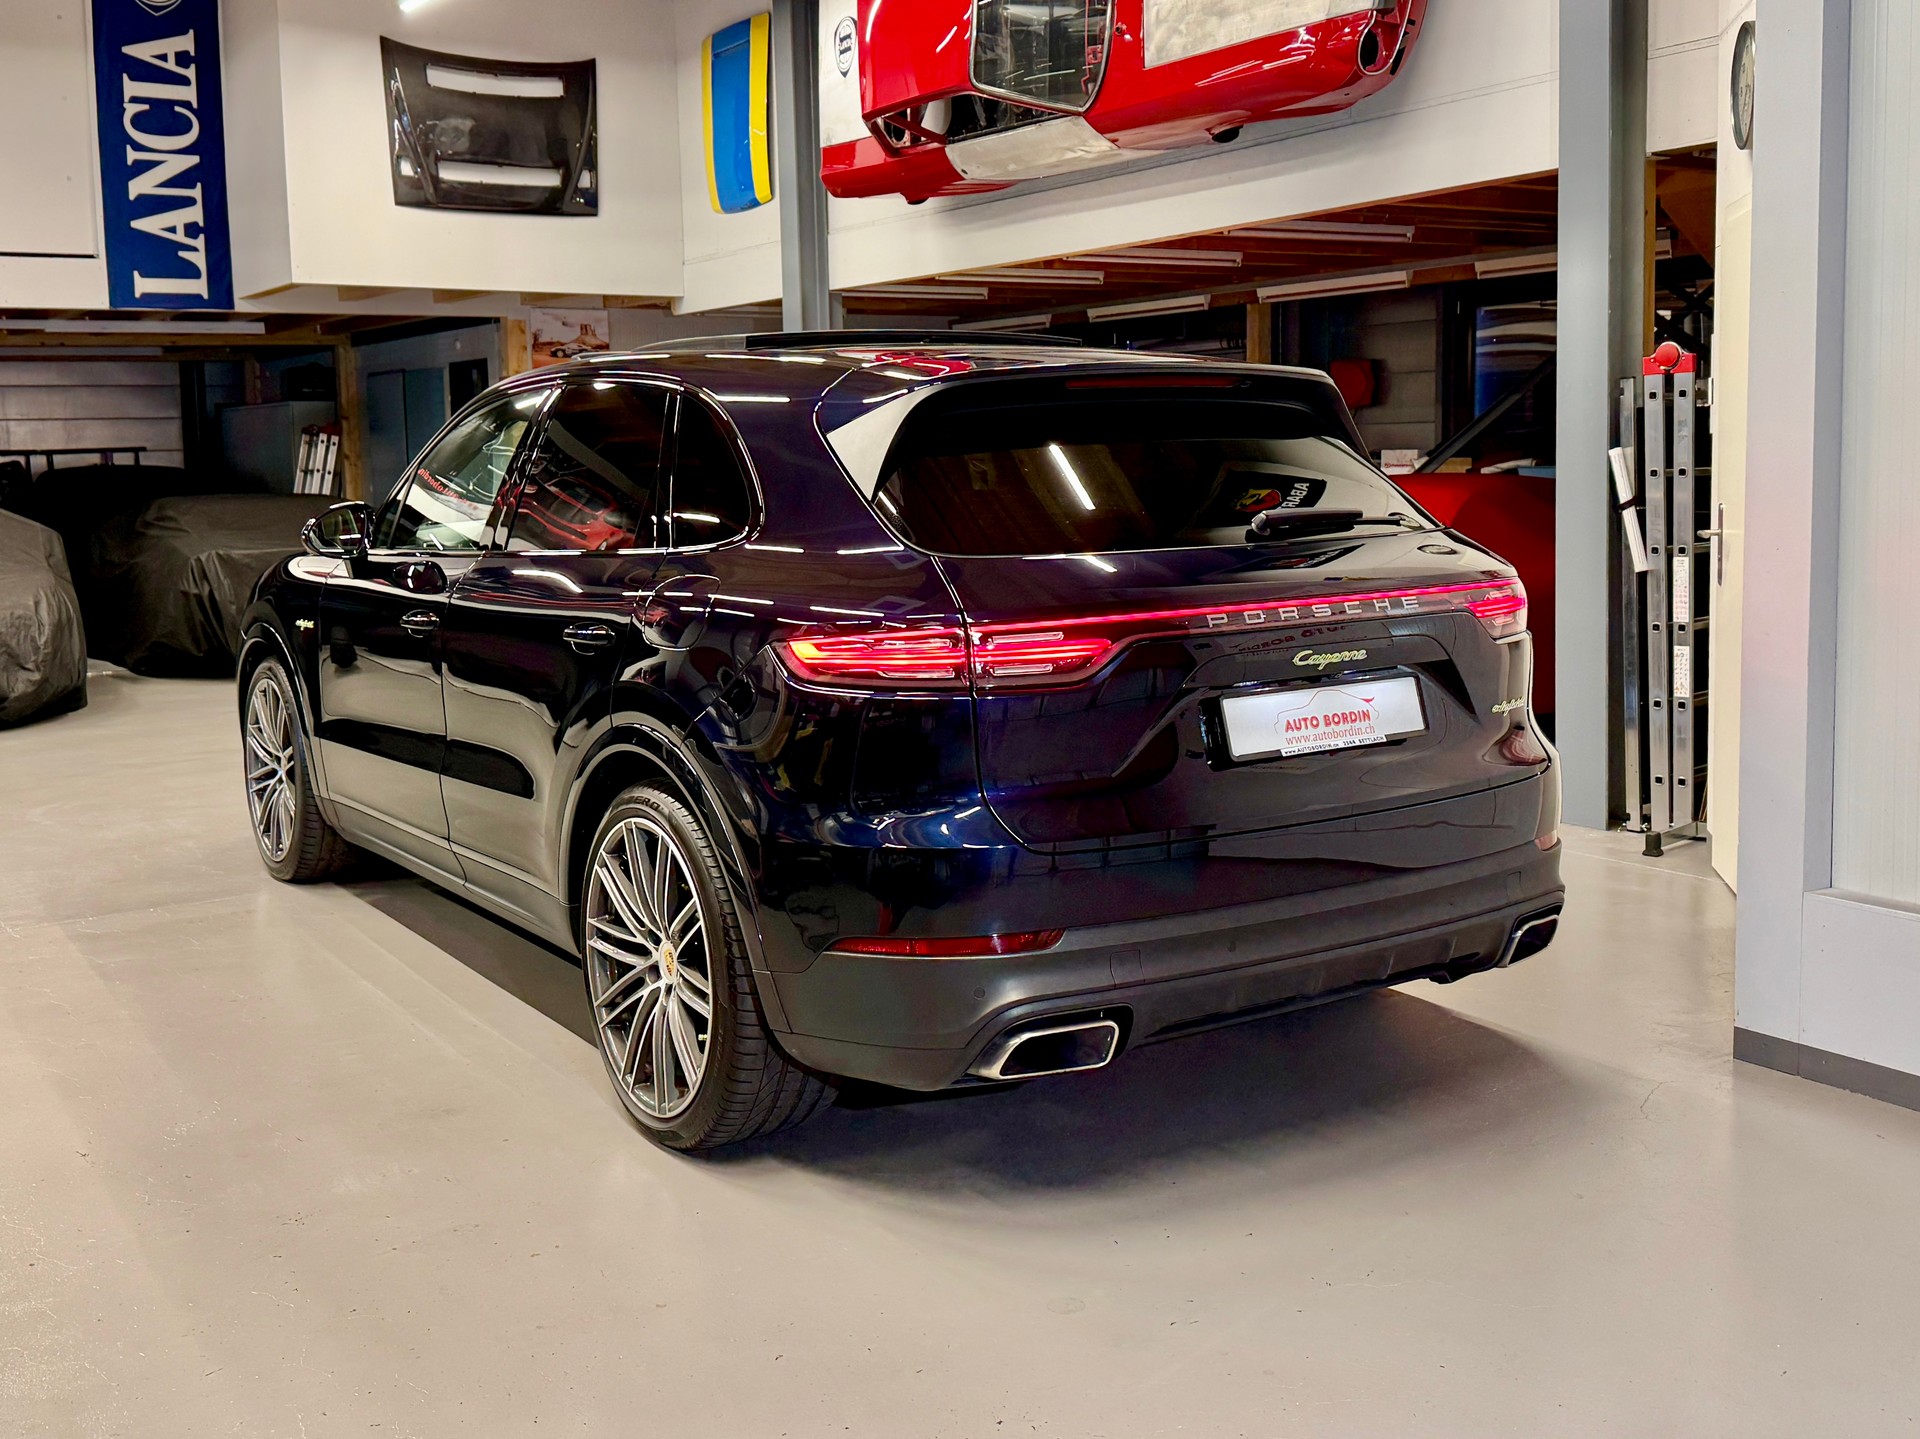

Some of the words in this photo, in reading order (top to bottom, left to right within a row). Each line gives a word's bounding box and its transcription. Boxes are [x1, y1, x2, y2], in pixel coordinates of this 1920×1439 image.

[121, 29, 209, 300] LANCIA
[1206, 597, 1419, 628] PORSCHE
[1292, 649, 1368, 670] Cayenne
[1285, 715, 1320, 733] AUTO
[1323, 709, 1372, 728] BORDIN
[1285, 723, 1376, 746] www.autobordin.ch
